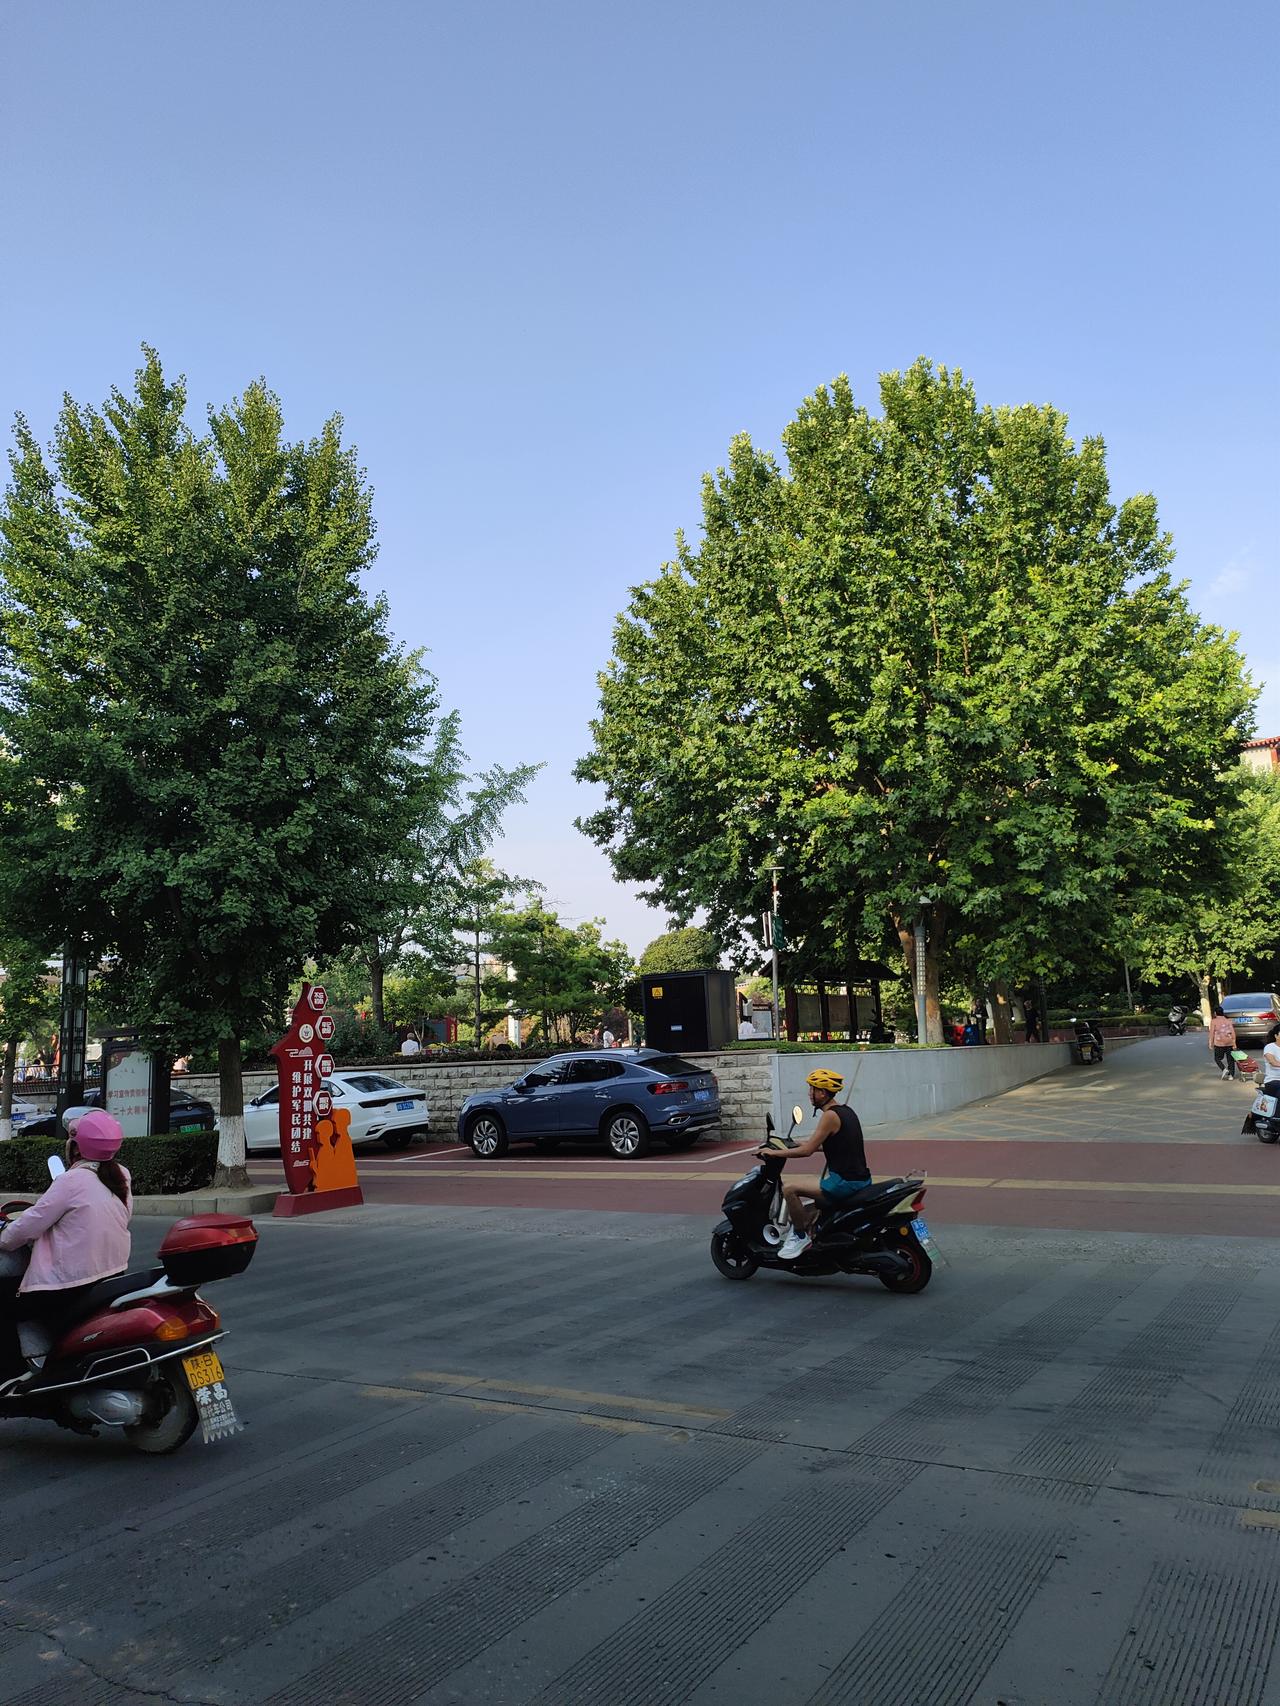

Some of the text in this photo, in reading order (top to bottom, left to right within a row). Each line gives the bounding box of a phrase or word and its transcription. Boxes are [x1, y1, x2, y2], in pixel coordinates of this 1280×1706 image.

[291, 1071, 301, 1153] 维护军民团结
[190, 1366, 222, 1387] DS316
[196, 1382, 228, 1405] 荣昌
